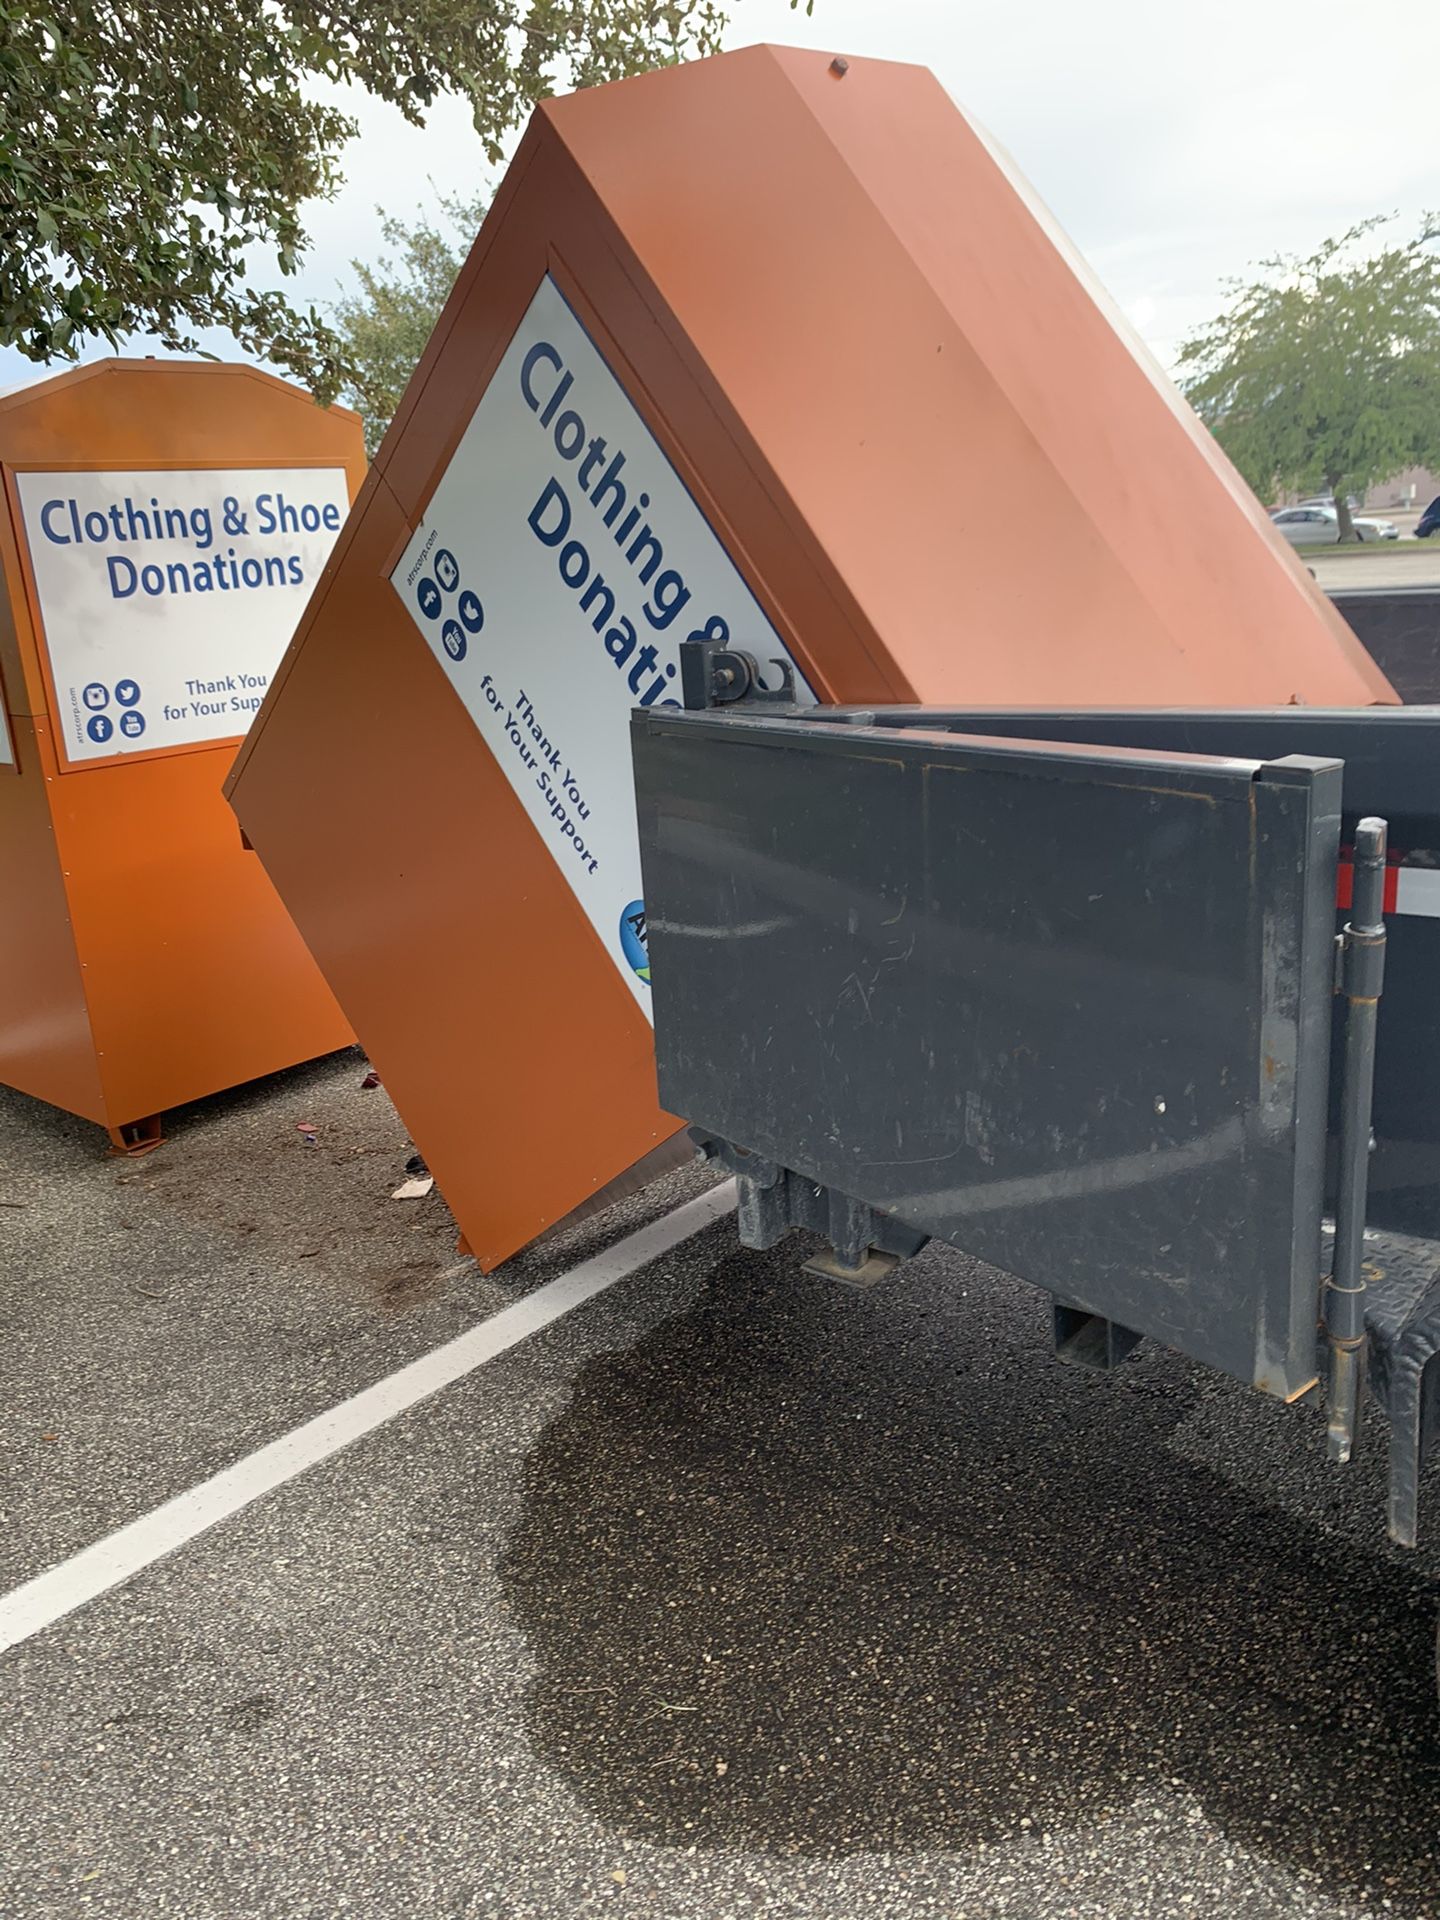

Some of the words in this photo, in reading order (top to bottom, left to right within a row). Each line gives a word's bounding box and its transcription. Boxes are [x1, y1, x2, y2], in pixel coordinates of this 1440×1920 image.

[520, 342, 692, 630] Clothing
[40, 497, 213, 549] Clothing
[223, 496, 249, 536] &
[255, 493, 340, 534] Shoe
[106, 548, 304, 599] Donations
[406, 529, 438, 586] atrscorp.com
[527, 476, 684, 707] Donati
[163, 705, 187, 720] for
[190, 701, 227, 716] Your
[230, 696, 264, 712] Sup
[185, 676, 236, 695] Thank
[238, 674, 267, 689] You
[69, 687, 84, 744] atrscorp.com
[479, 675, 504, 714] for
[503, 711, 538, 770] Your
[536, 771, 600, 875] Support
[514, 689, 562, 772] Thank
[561, 768, 591, 821] You
